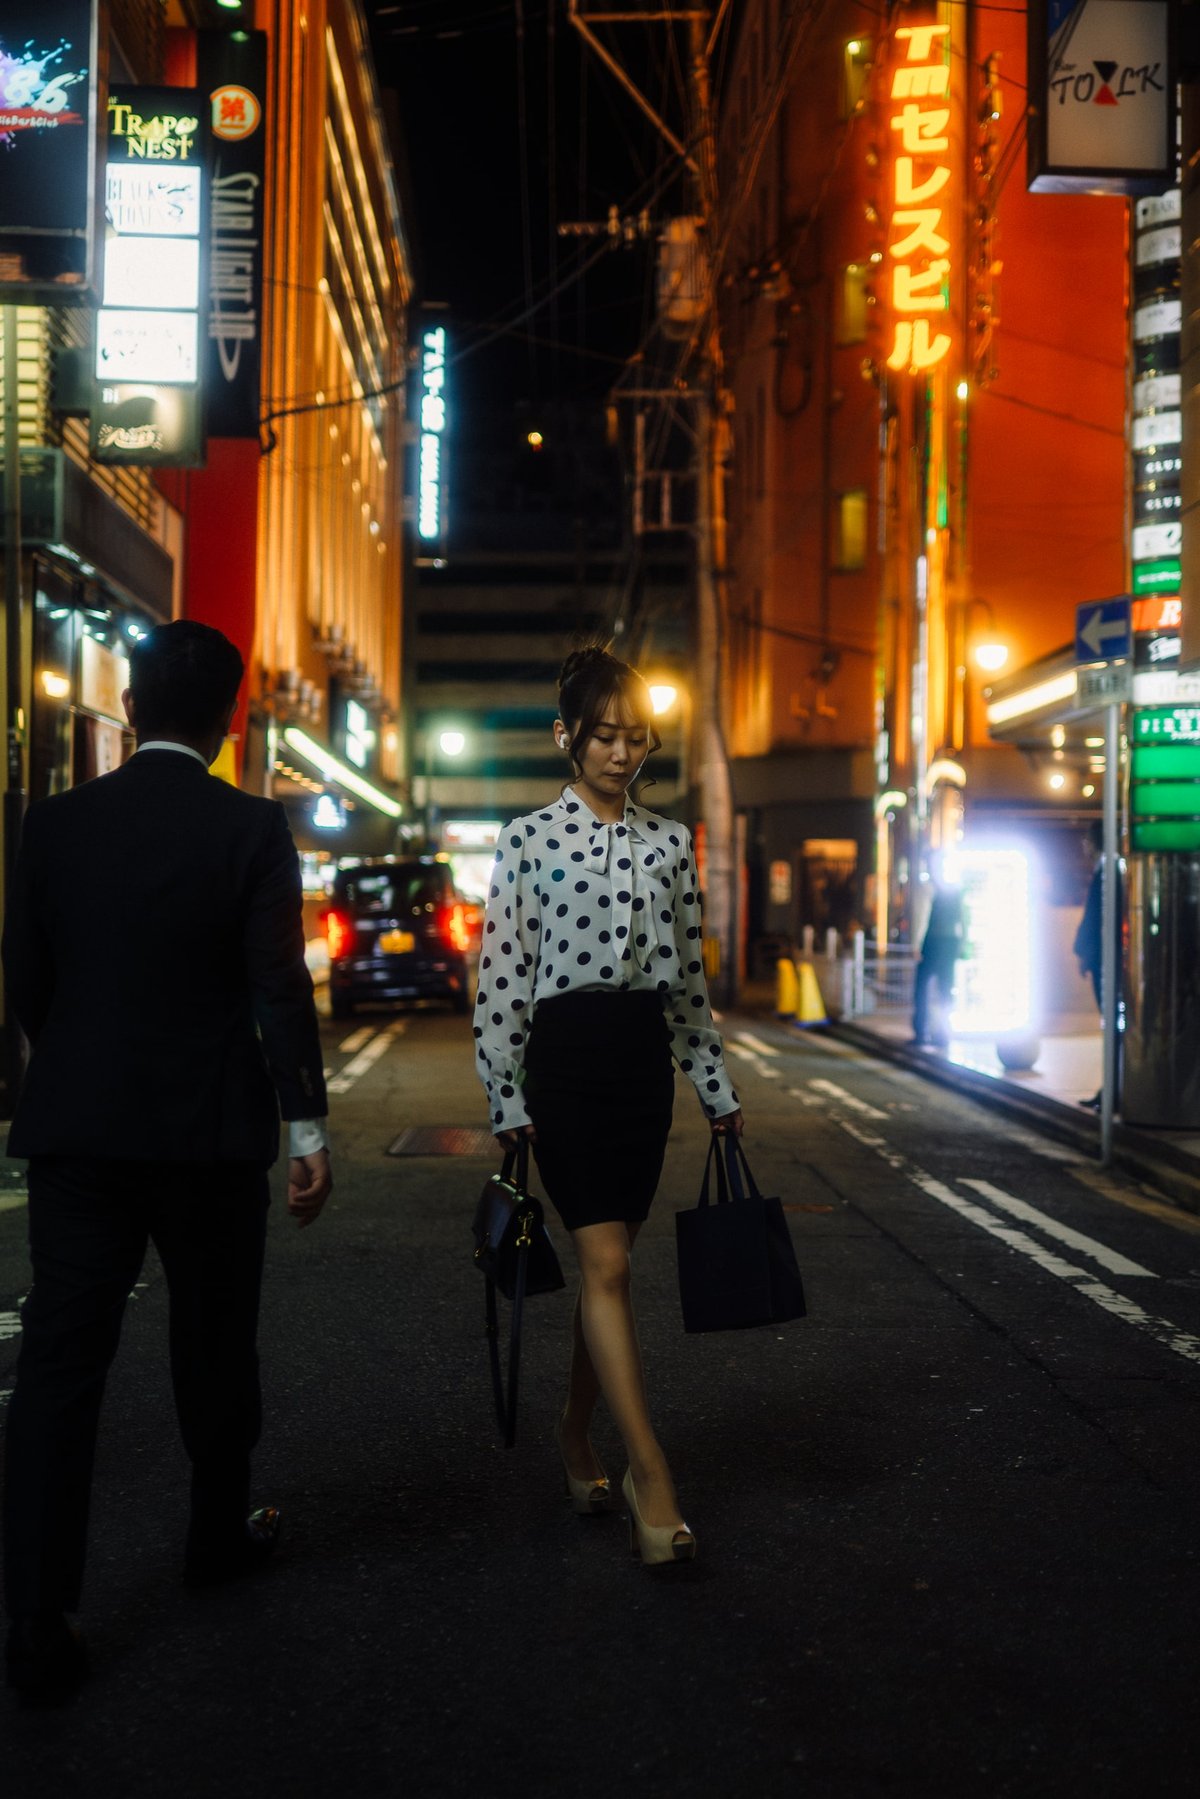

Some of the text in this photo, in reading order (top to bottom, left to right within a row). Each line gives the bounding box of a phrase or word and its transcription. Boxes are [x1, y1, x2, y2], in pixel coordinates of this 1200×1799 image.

[0, 69, 84, 113] 86
[127, 134, 193, 160] NEST
[211, 171, 260, 231] STAR
[209, 237, 259, 304] LIGHT
